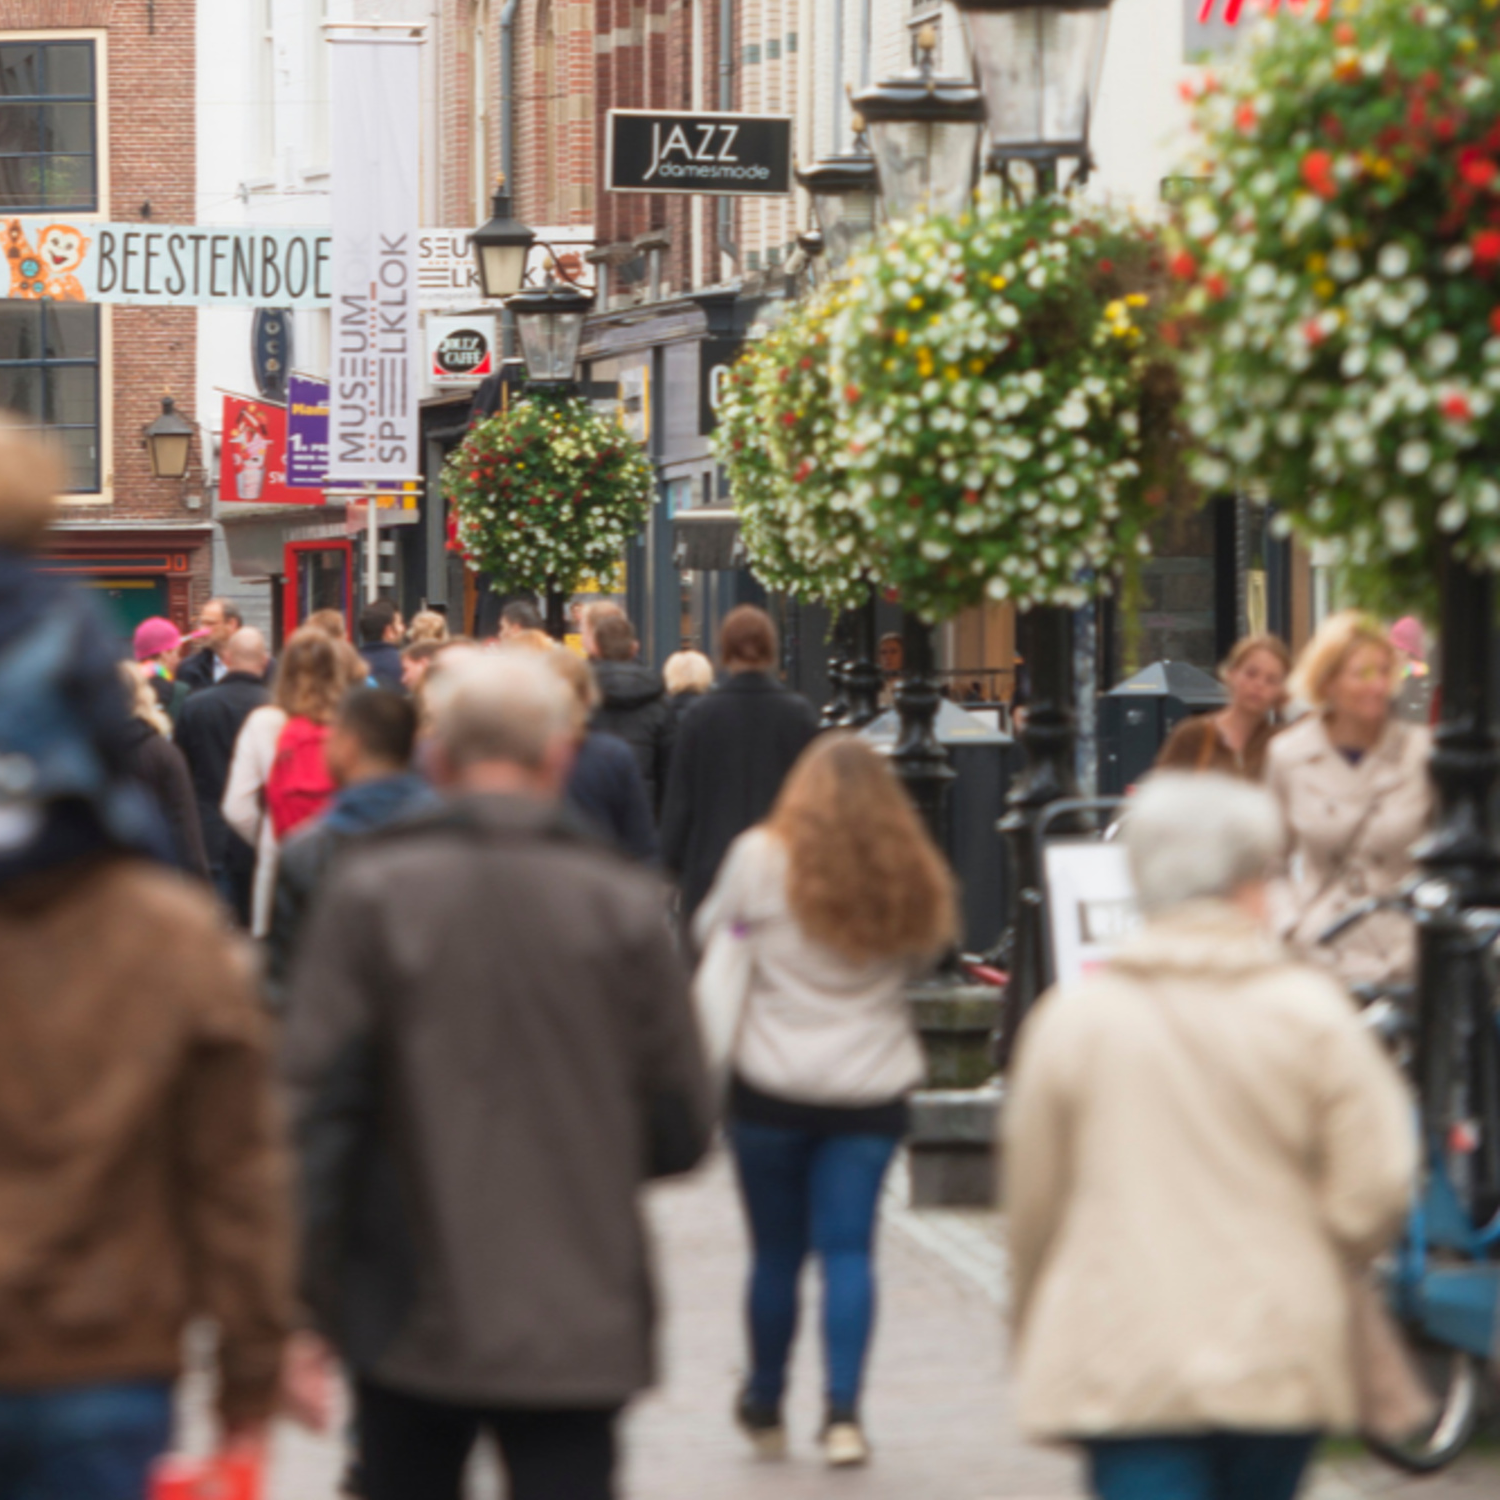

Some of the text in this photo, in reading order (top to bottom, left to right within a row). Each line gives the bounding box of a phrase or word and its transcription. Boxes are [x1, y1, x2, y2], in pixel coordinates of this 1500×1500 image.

[642, 122, 739, 181] JAZZ
[658, 161, 771, 180] damesmode
[97, 230, 332, 299] BEESTENBOE
[338, 294, 368, 463] MUSEUM
